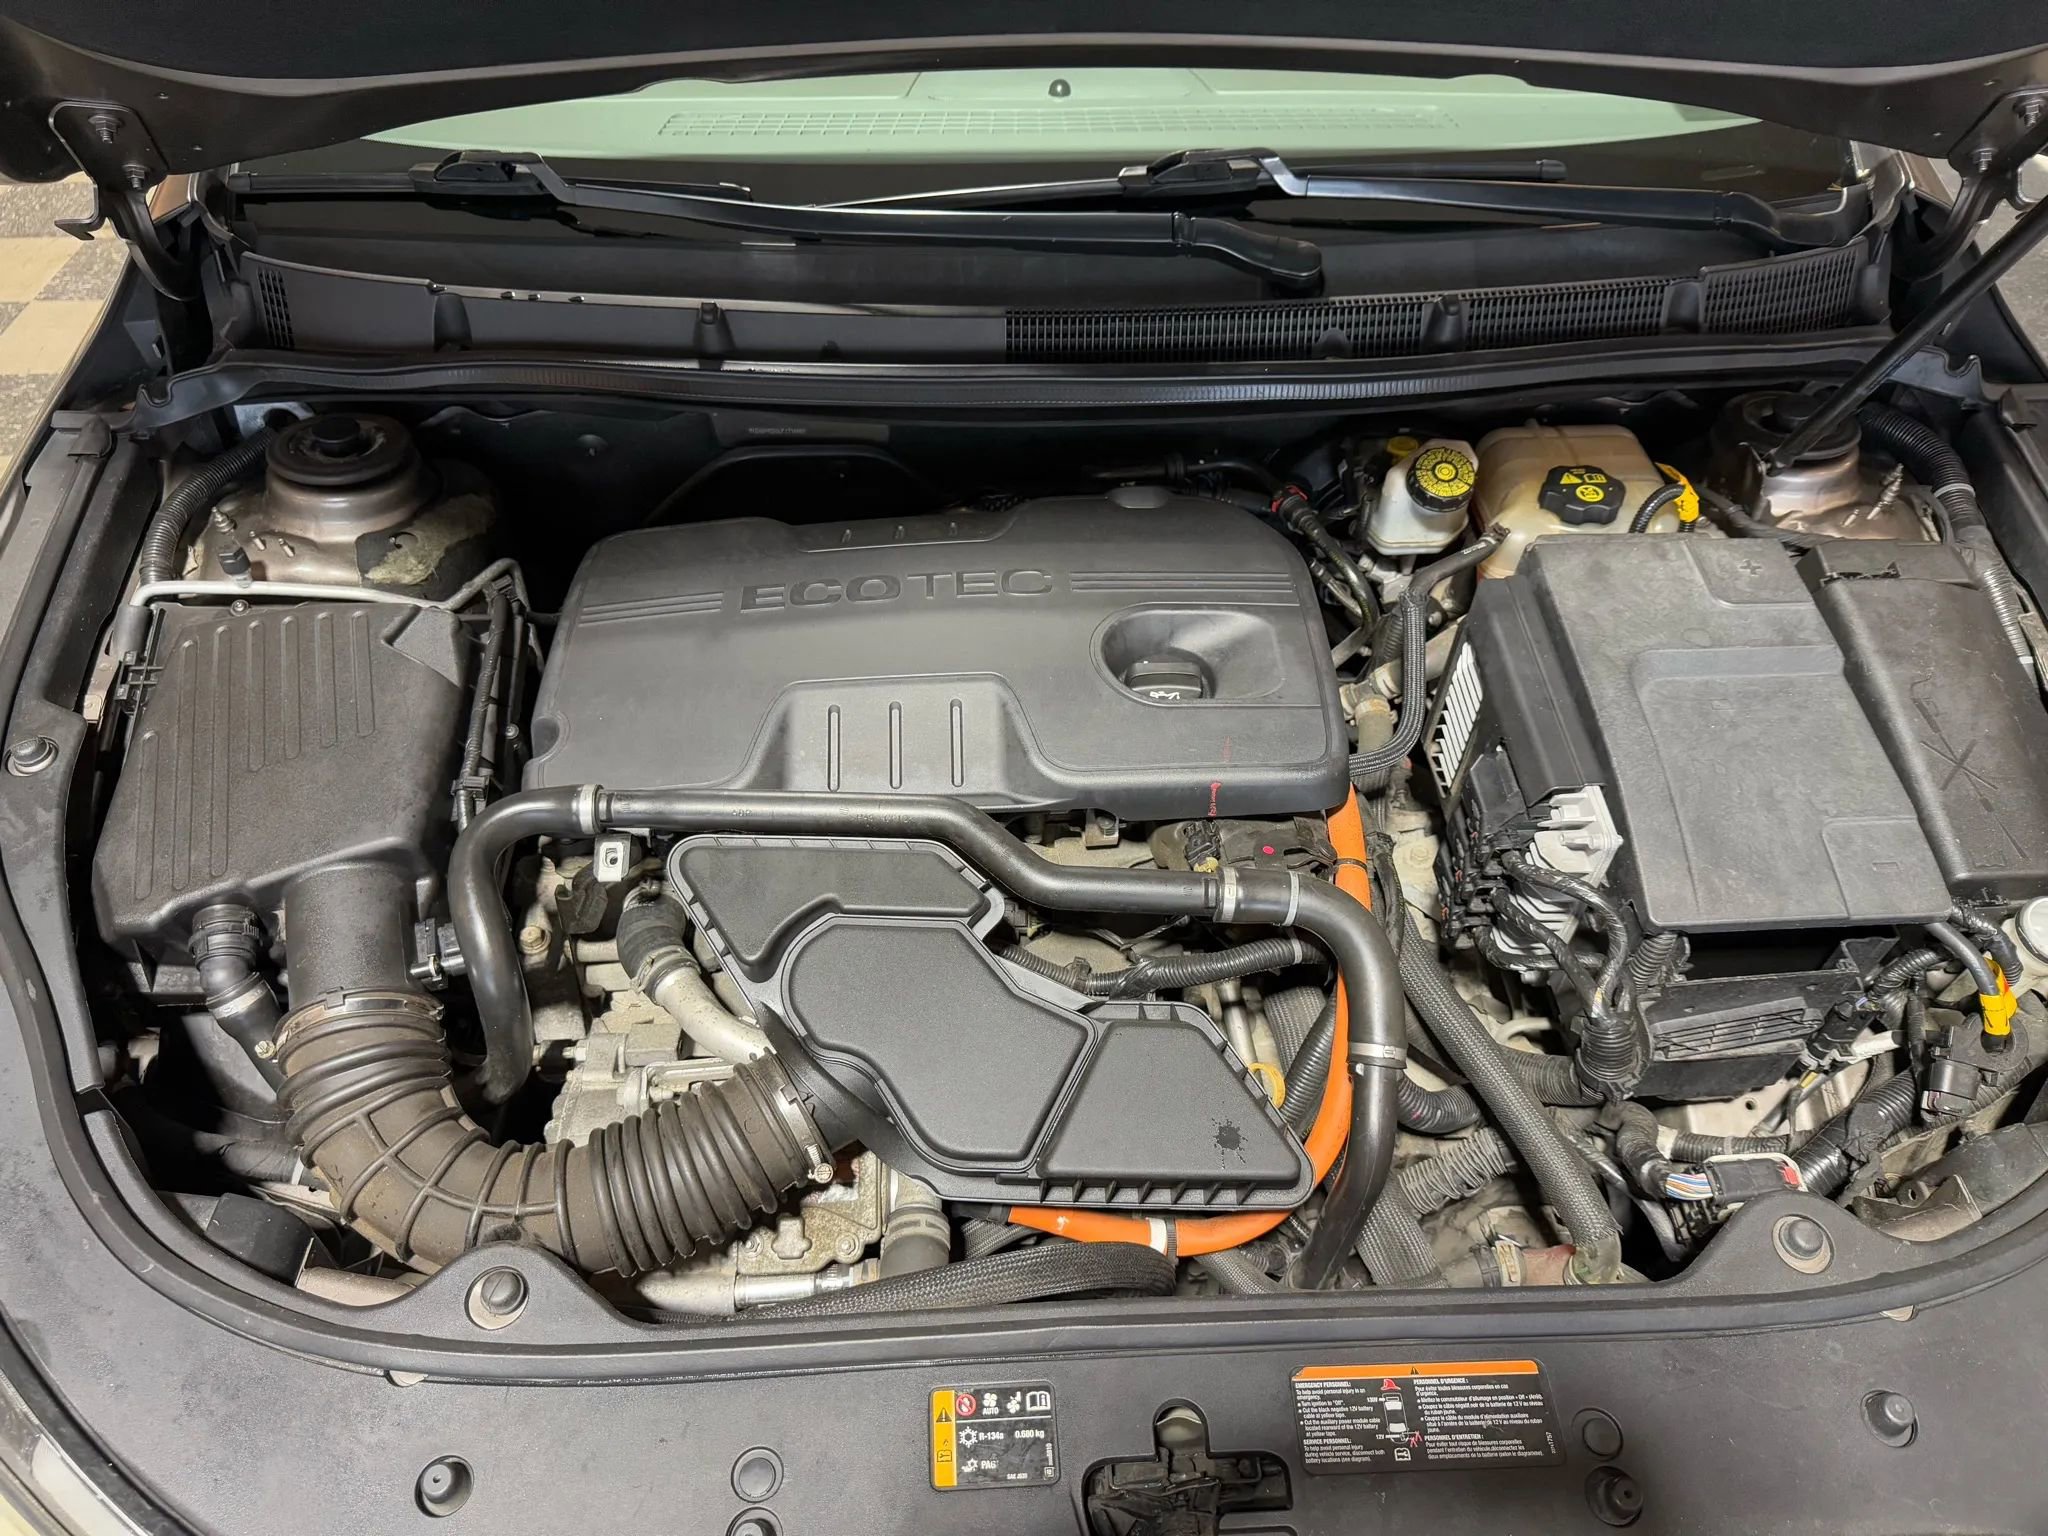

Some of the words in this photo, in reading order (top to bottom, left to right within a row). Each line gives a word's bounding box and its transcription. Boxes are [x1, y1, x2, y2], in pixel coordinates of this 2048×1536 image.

[740, 568, 1053, 614] ECOTEC
[982, 1406, 999, 1416] AUTO
[979, 1432, 1004, 1440] R-134a
[1034, 1429, 1044, 1438] kg
